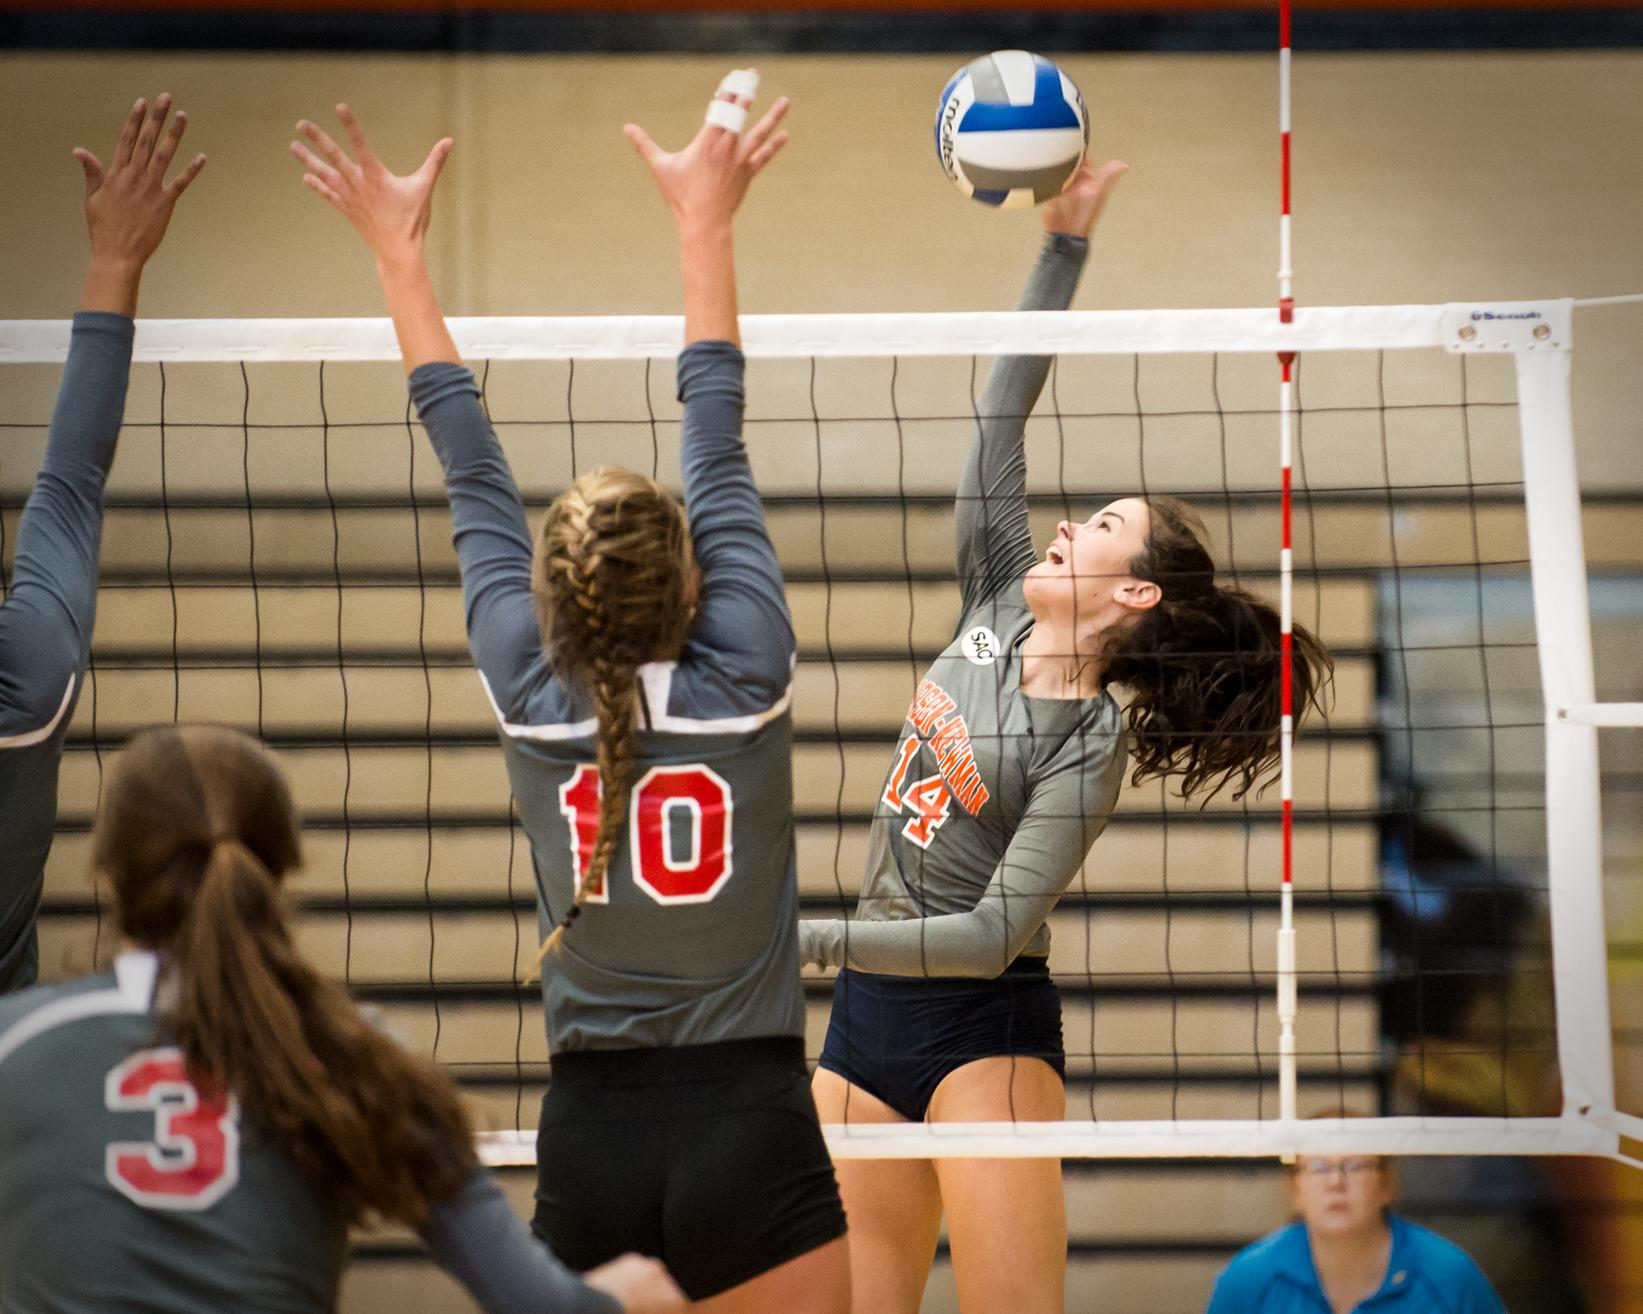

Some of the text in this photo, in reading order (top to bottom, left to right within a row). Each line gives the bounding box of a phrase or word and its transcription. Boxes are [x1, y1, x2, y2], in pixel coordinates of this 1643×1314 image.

[970, 631, 993, 660] SAC
[558, 763, 734, 906] 10
[881, 733, 952, 849] 14
[105, 1046, 239, 1211] 3
